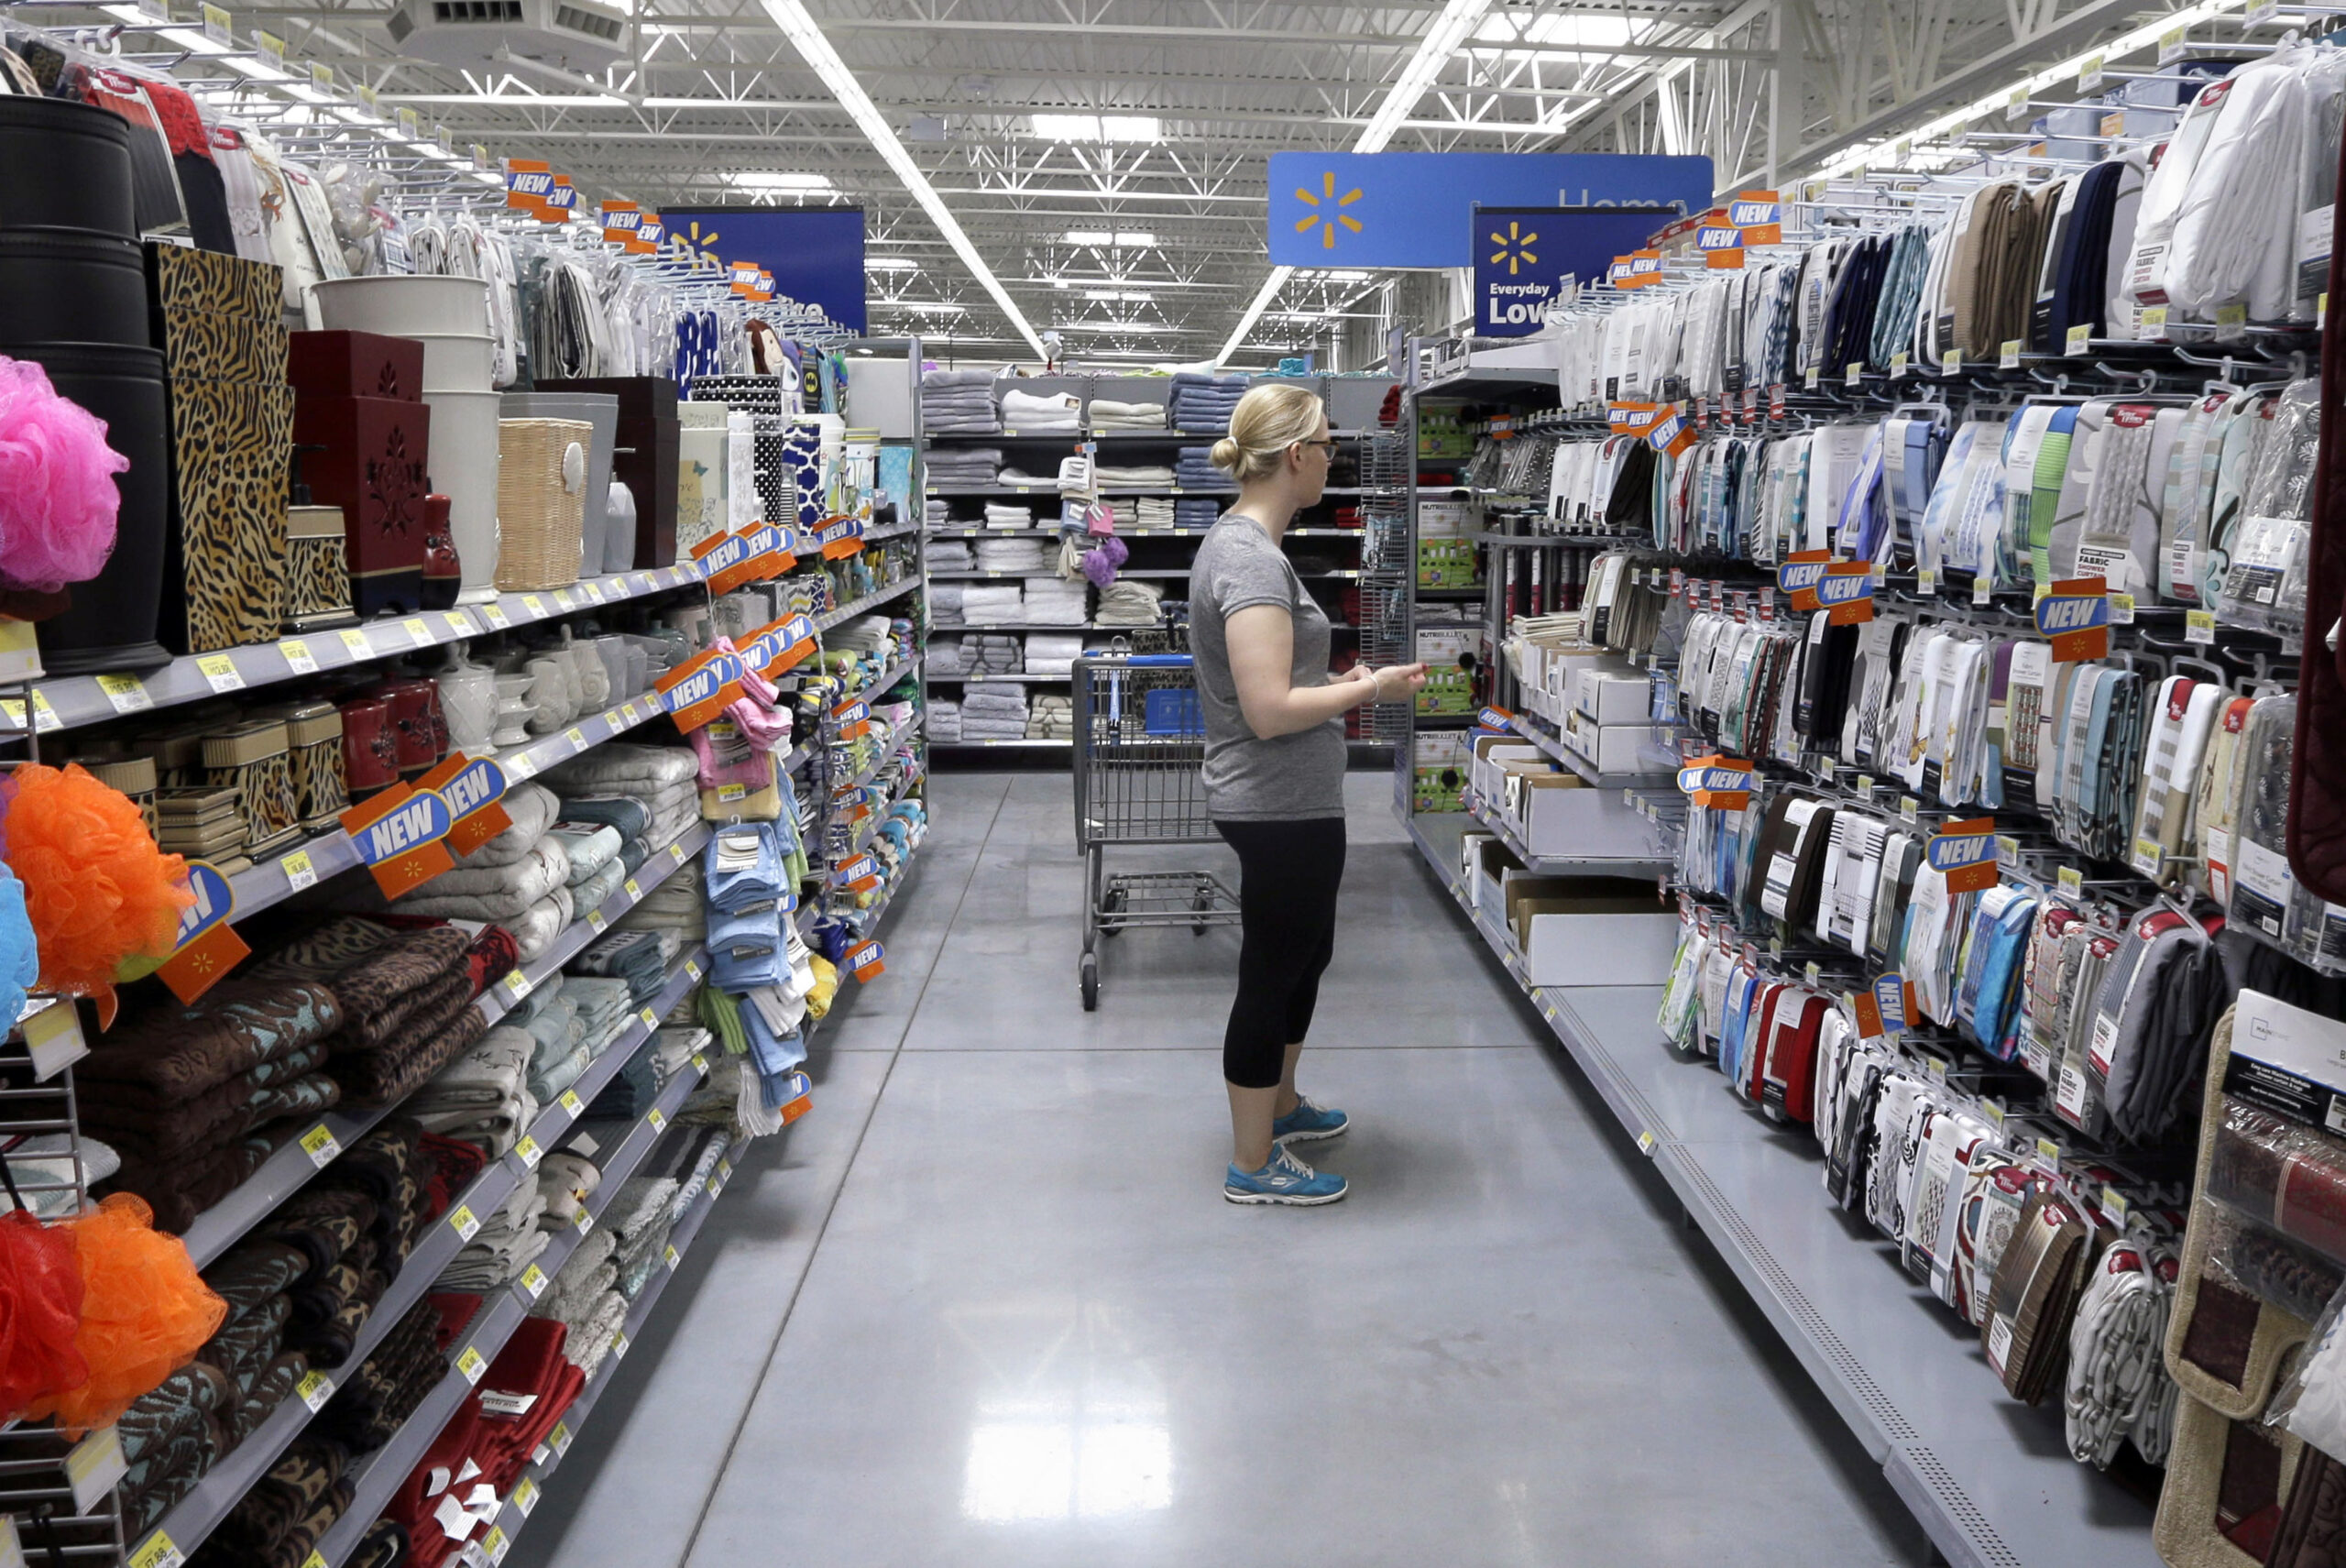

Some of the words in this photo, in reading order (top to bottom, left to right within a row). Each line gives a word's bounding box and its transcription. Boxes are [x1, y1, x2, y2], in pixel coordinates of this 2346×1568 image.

[513, 174, 552, 194] NEW
[547, 186, 572, 206] EW
[606, 210, 641, 229] NEW
[1734, 204, 1775, 224] NEW
[640, 224, 662, 240] EW
[1700, 229, 1739, 247] NEW
[1632, 259, 1658, 272] NEW
[733, 270, 760, 283] NEW
[755, 278, 773, 291] EW
[1490, 282, 1550, 298] Everyday
[1489, 297, 1547, 324] Low
[1492, 420, 1510, 432] NEW
[1628, 411, 1654, 425] NEW
[1653, 418, 1679, 448] NEW
[822, 521, 848, 543] NEW
[707, 538, 741, 575] NEW
[2078, 555, 2110, 566] FABRIC
[1784, 565, 1825, 587] NEW
[1824, 576, 1866, 598] NEW
[2043, 598, 2099, 630] NEW
[672, 672, 711, 710] NEW
[1481, 709, 1508, 730] NEW
[442, 763, 491, 817] NEW
[1706, 771, 1742, 789] NEW
[371, 797, 433, 861] NEW
[1935, 837, 1986, 865] NEW
[847, 858, 872, 879] NEW
[853, 944, 879, 969] NEW
[1879, 981, 1904, 1023] NEW
